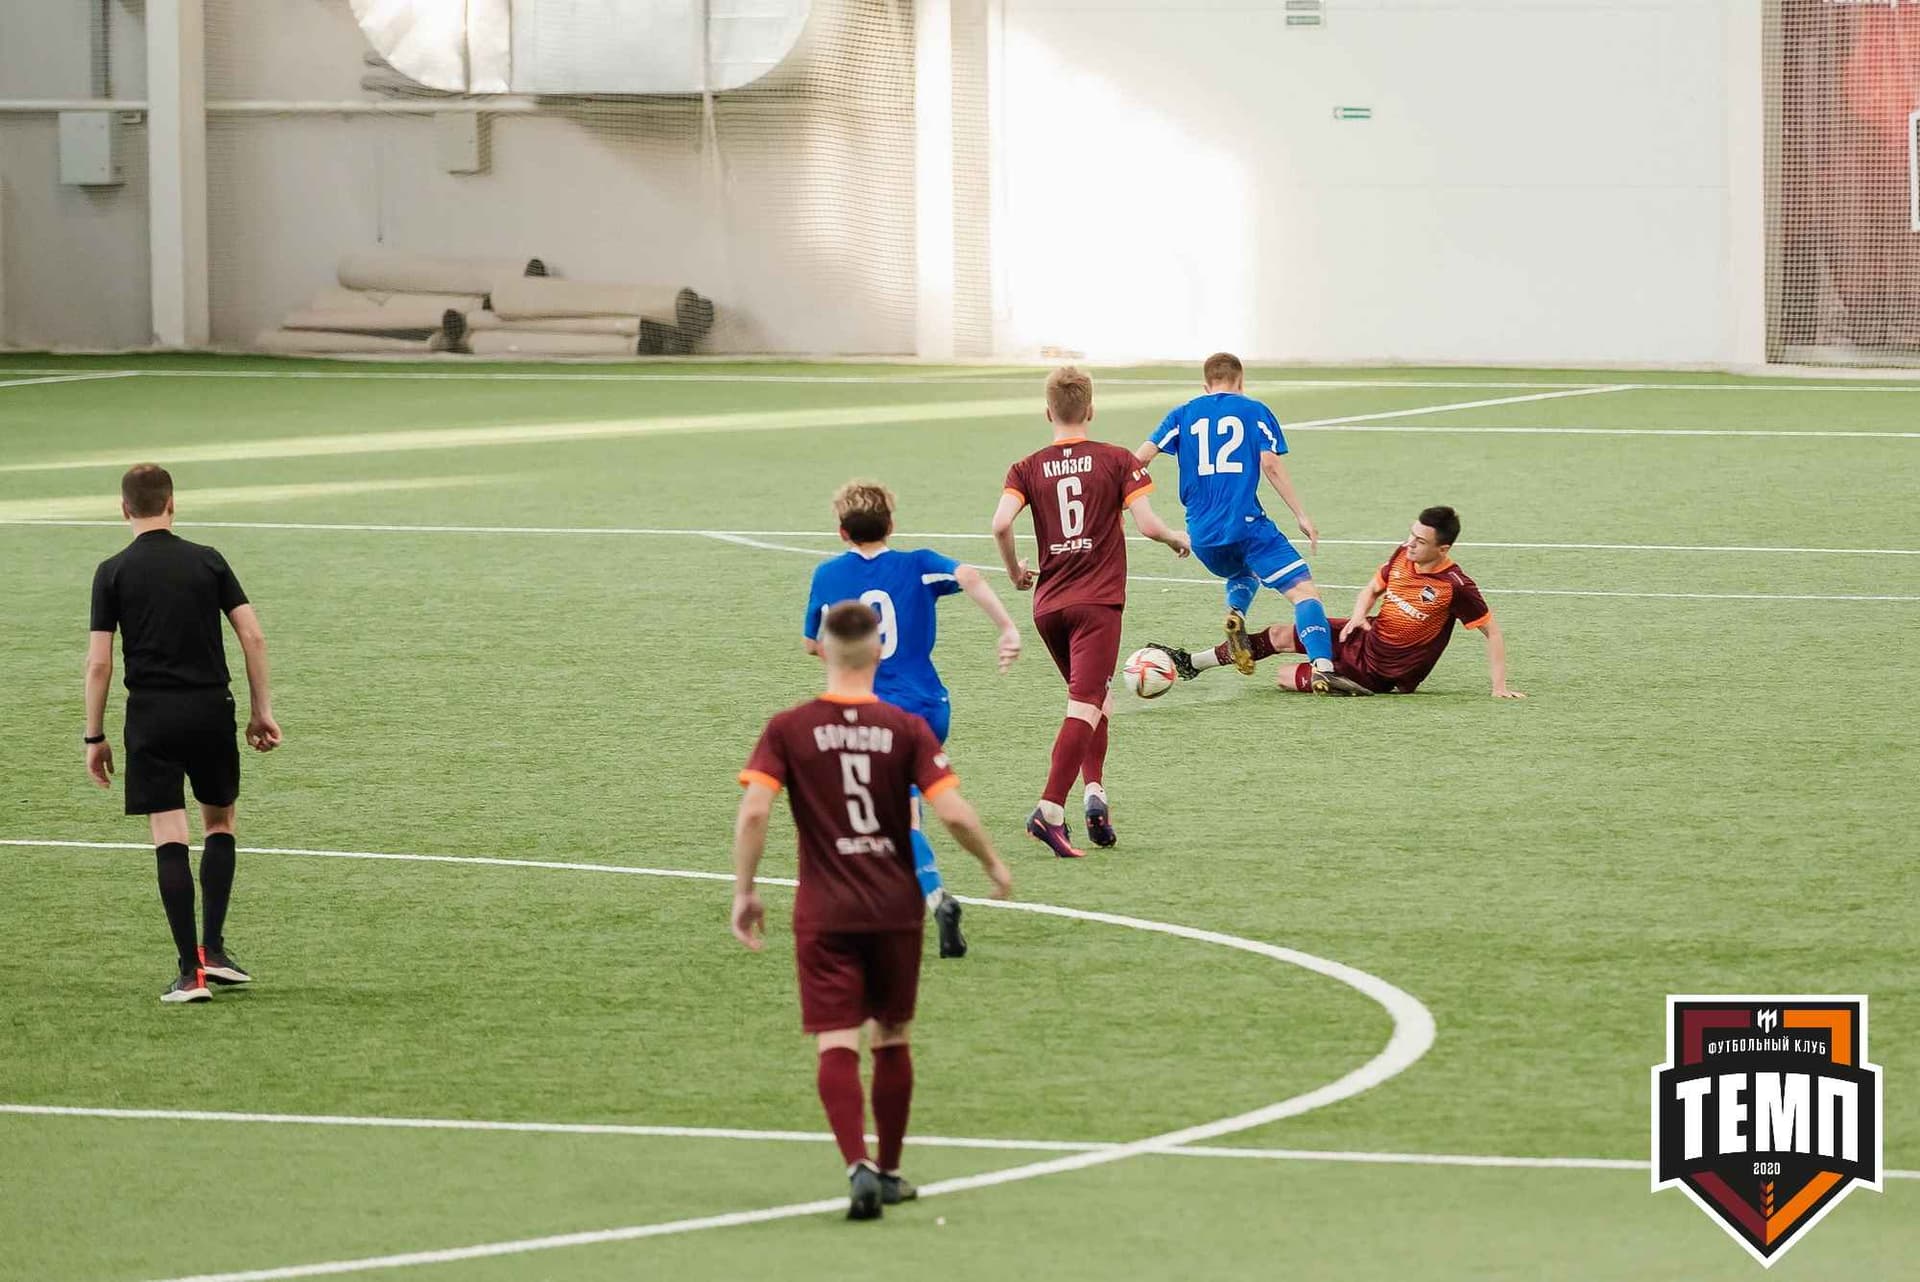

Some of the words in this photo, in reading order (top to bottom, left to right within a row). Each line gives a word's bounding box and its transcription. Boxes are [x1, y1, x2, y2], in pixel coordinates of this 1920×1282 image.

[1043, 455, 1093, 478] КНЯЗЕВ
[1190, 415, 1245, 476] 12
[1056, 476, 1085, 539] 6
[860, 589, 898, 660] 9
[840, 752, 881, 834] 5
